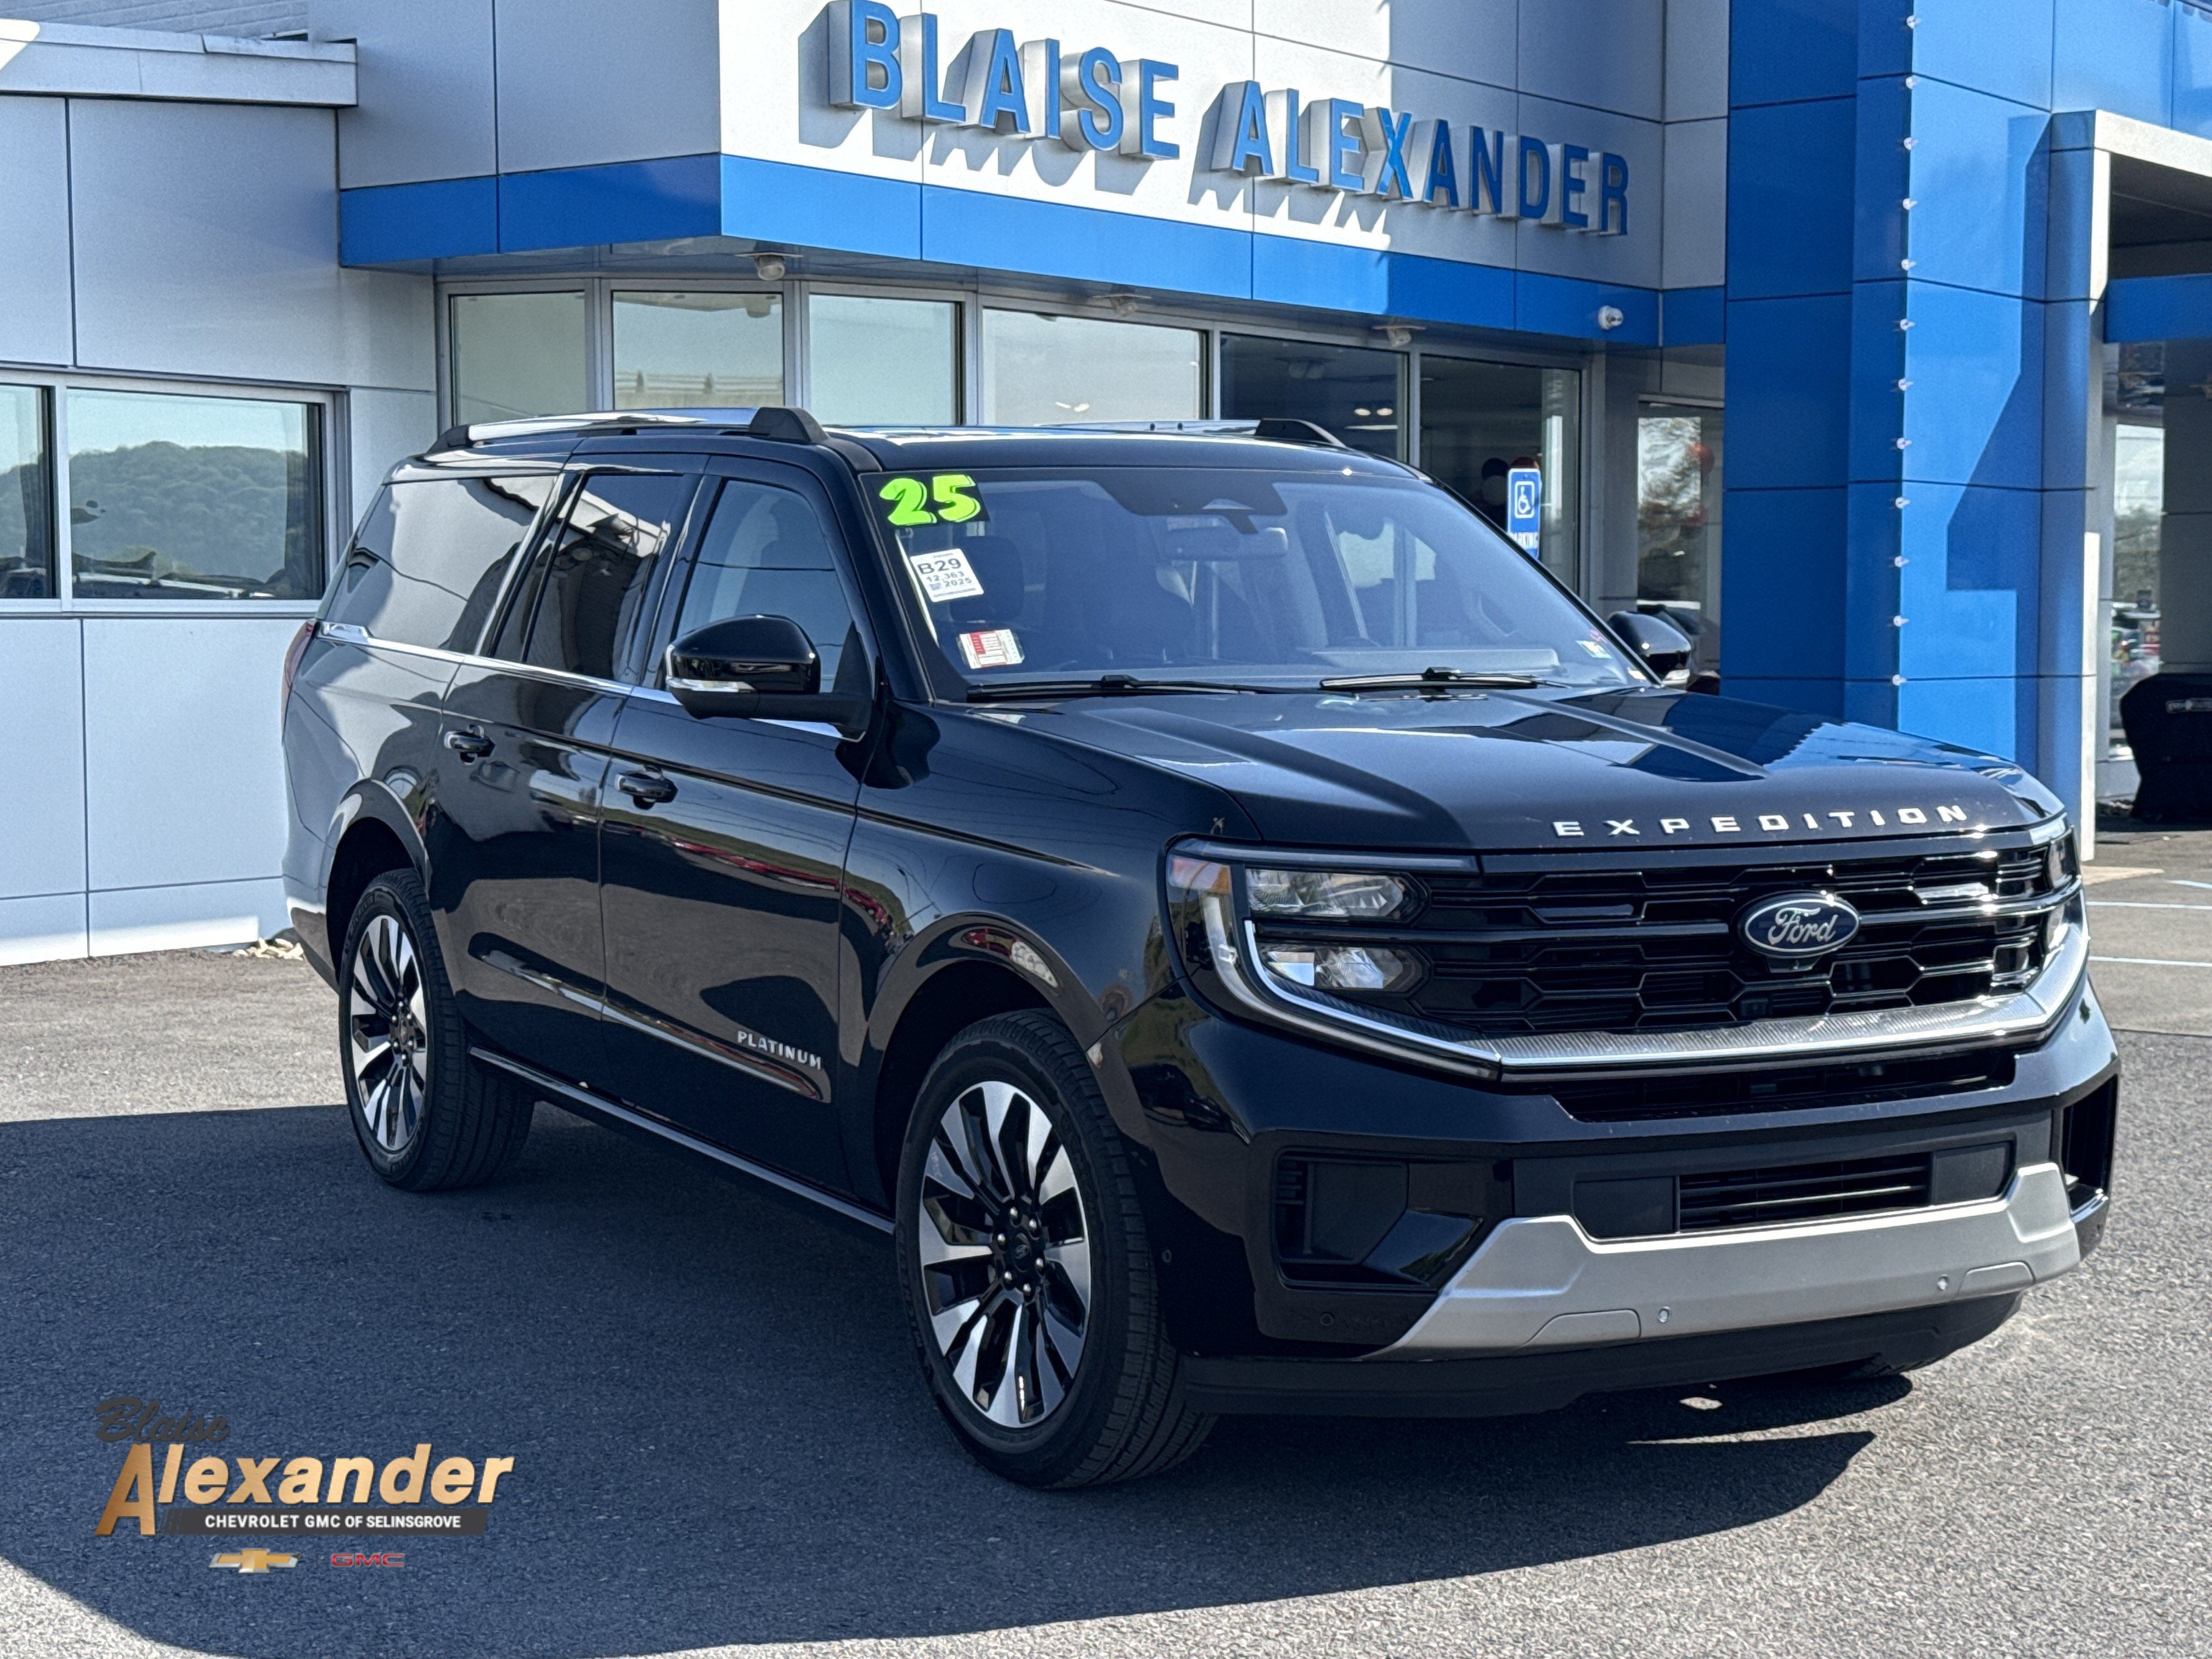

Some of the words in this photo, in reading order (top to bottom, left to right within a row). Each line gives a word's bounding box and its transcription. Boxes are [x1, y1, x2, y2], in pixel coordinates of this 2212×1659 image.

[851, 0, 1180, 159] BLAISE
[1233, 80, 1629, 236] ALEXANDER
[879, 474, 981, 526] 25
[917, 558, 962, 575] B29
[943, 578, 972, 588] 2025
[1552, 804, 1968, 837] EXPEDITION
[1768, 907, 1838, 945] Ford
[737, 1030, 822, 1070] PLATINUM
